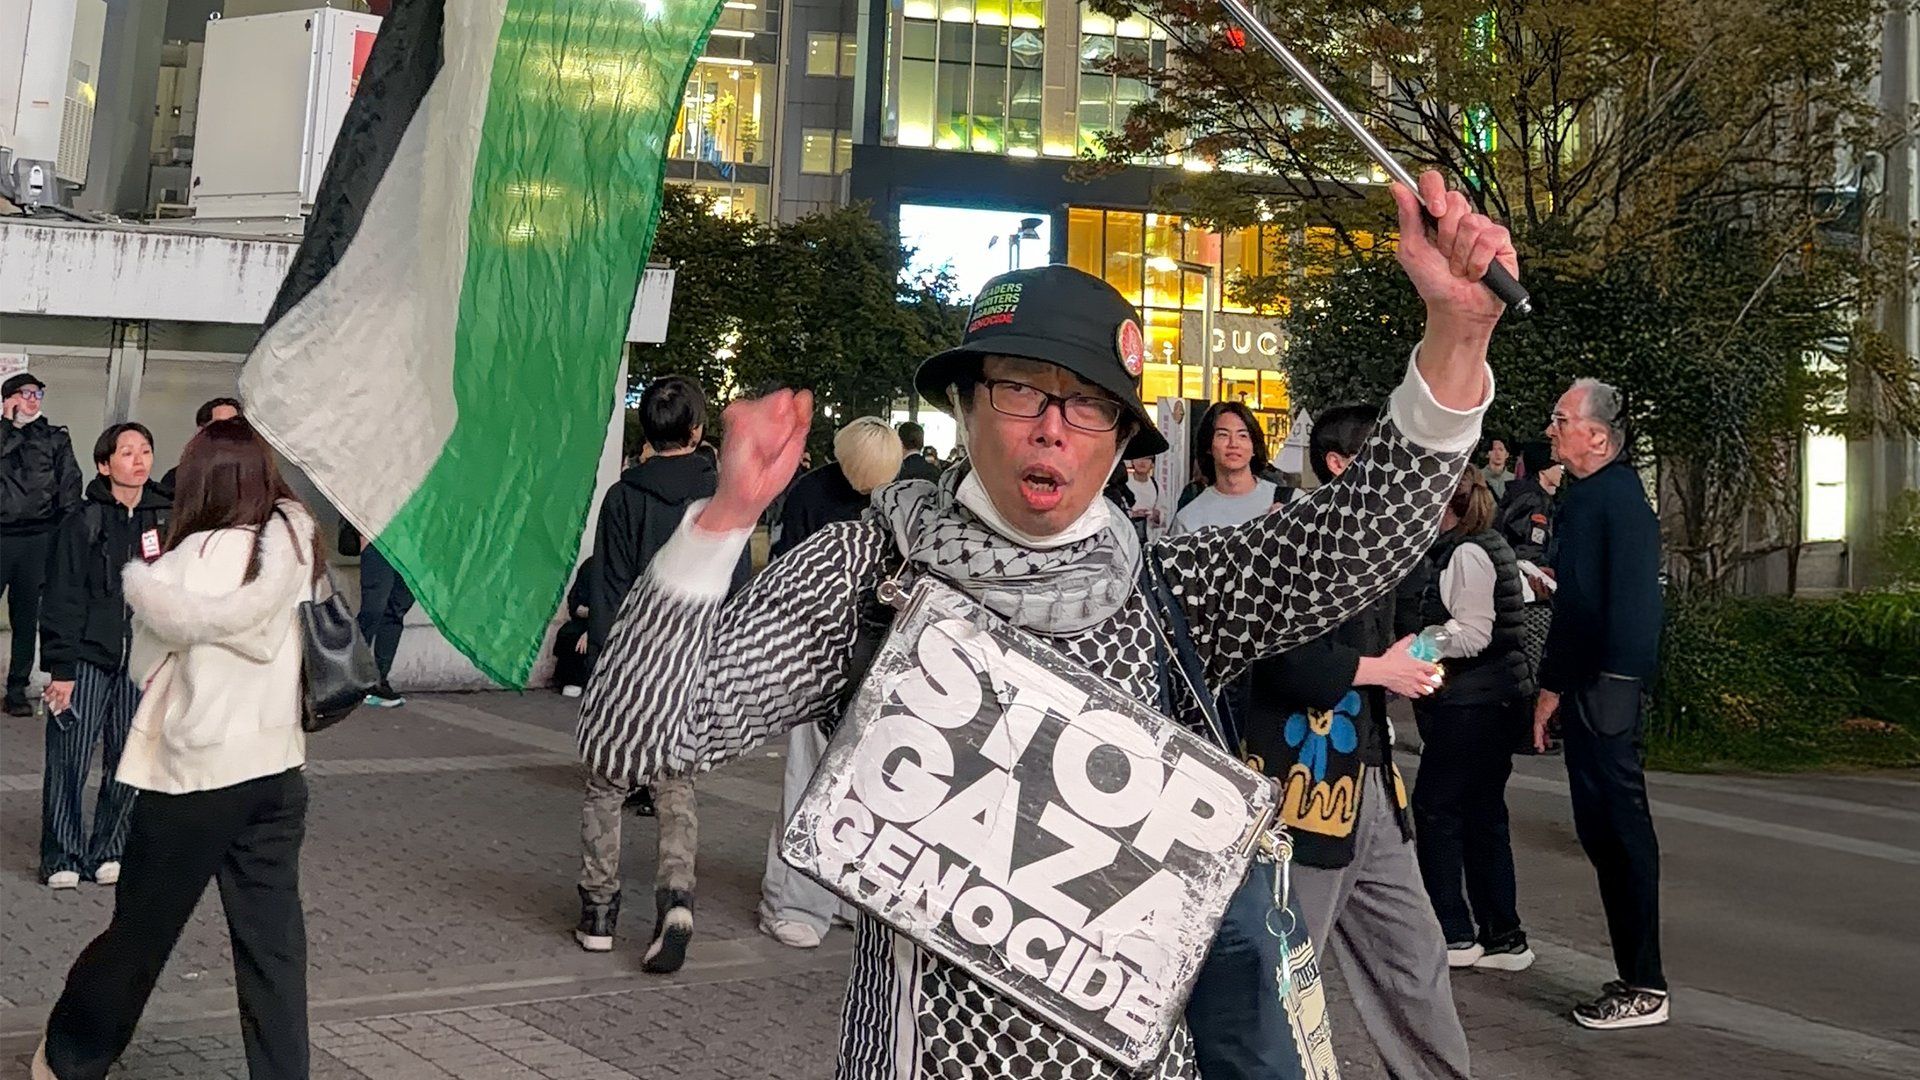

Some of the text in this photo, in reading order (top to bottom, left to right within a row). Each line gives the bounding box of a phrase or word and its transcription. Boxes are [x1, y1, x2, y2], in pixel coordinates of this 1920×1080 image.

[1212, 328, 1289, 356] GUC
[853, 714, 1188, 986] GAZA
[893, 619, 1248, 864] STOP
[815, 799, 1161, 1040] GENOCIDE
